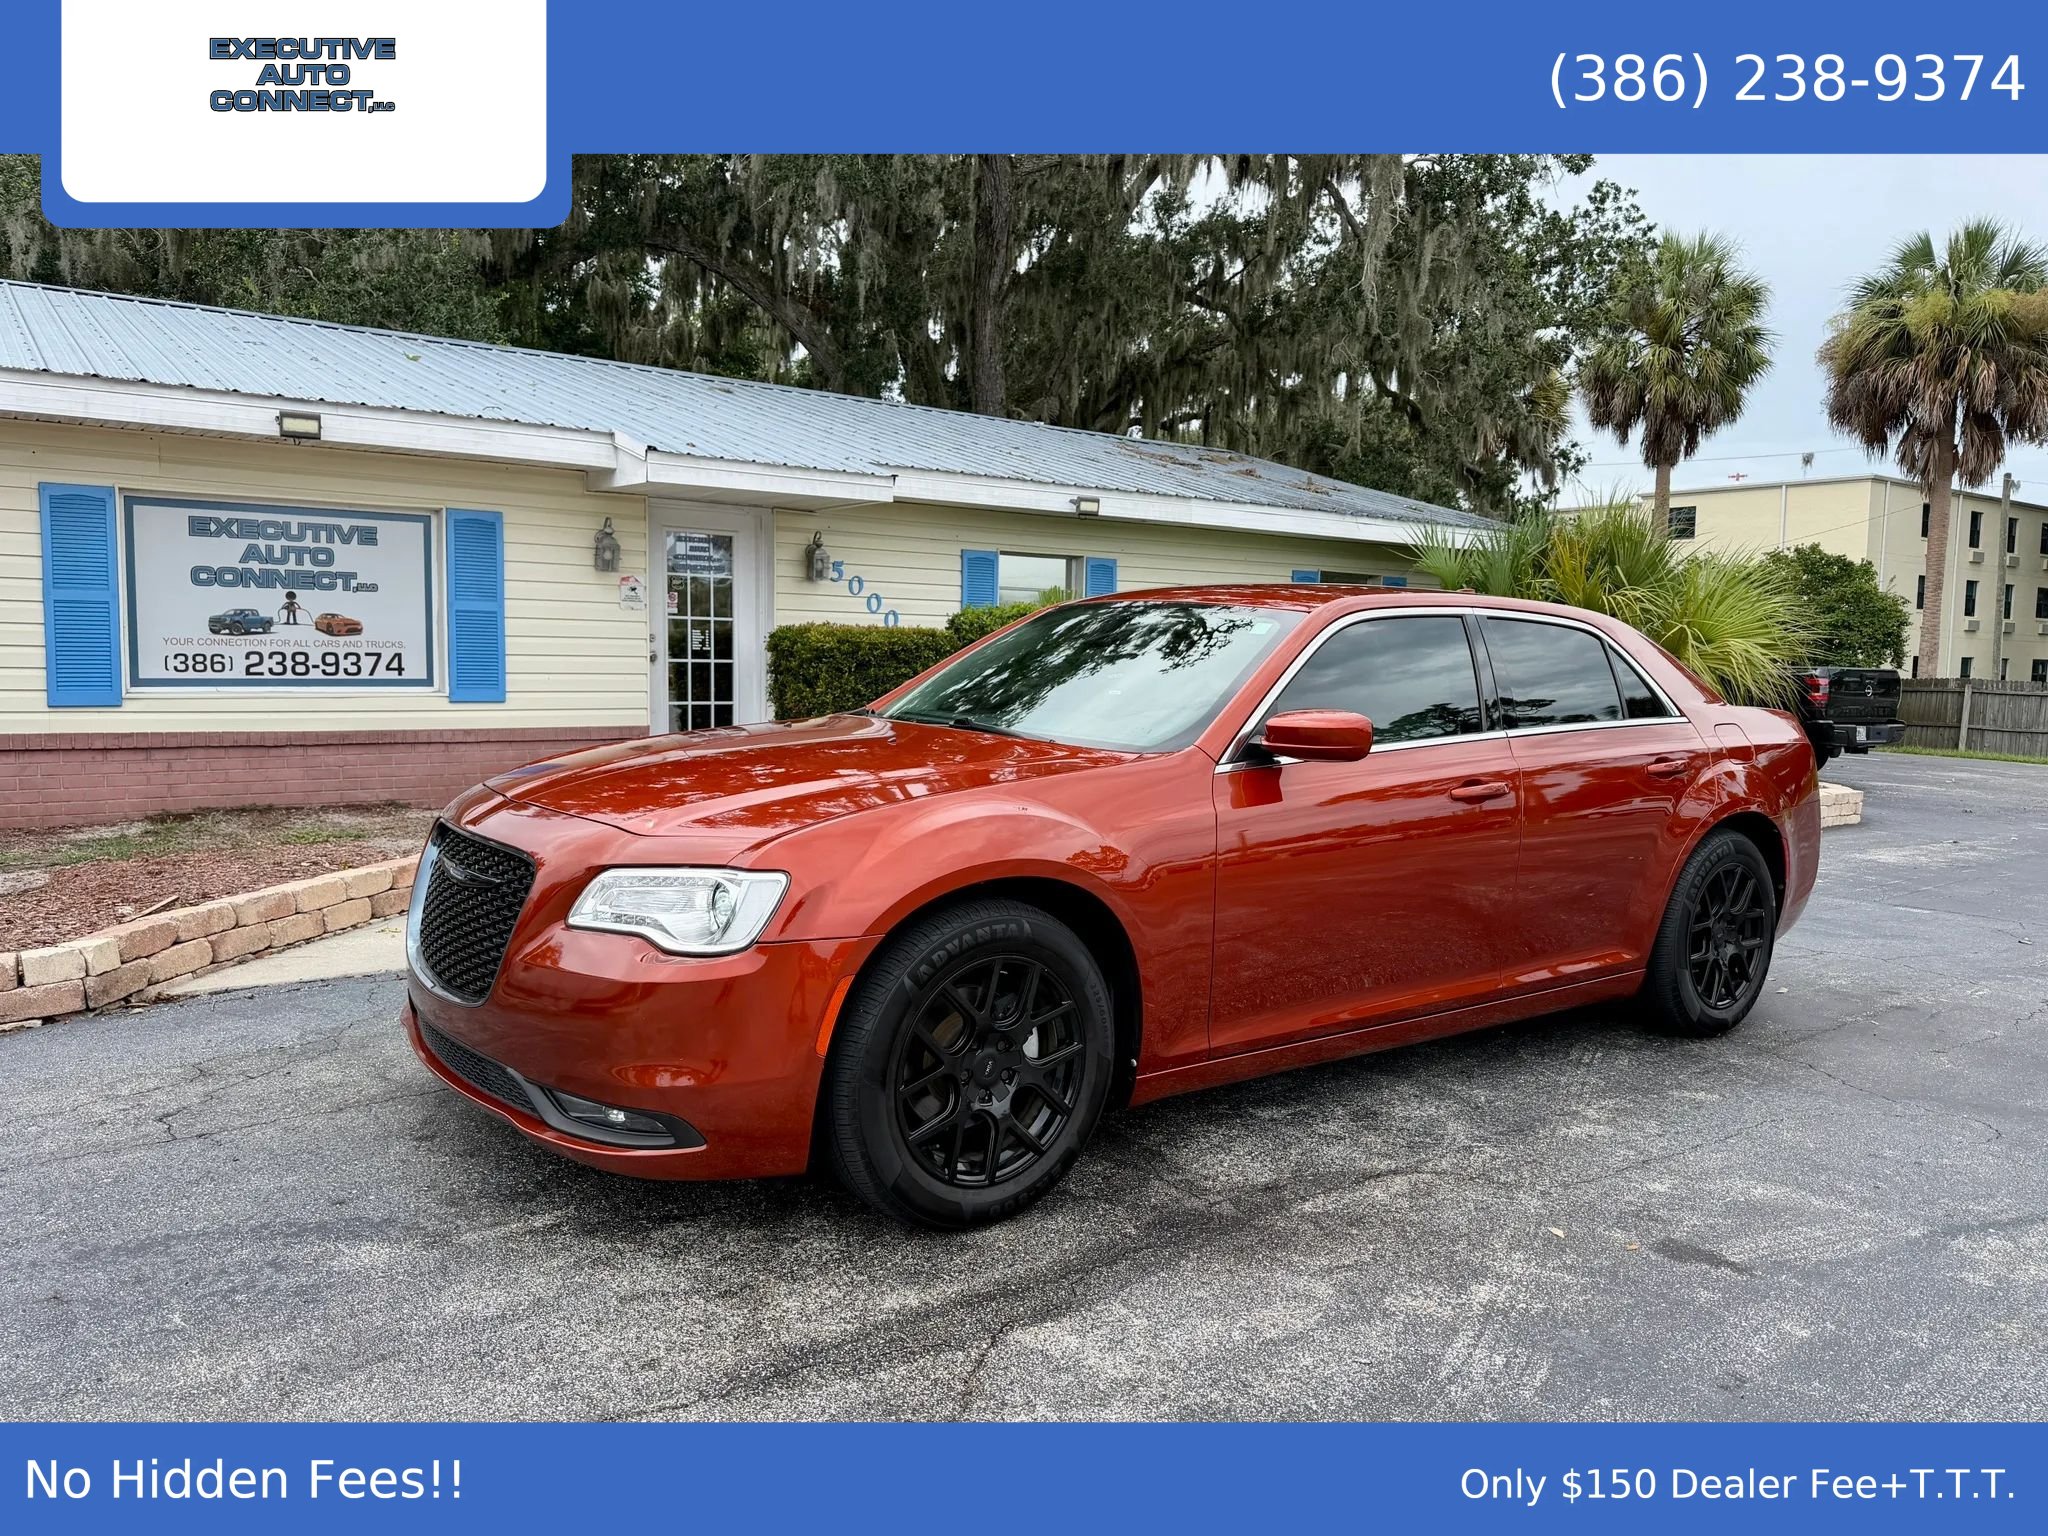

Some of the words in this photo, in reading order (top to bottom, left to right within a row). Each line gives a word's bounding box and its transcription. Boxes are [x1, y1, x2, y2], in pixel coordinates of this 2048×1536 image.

[188, 515, 378, 546] EXECUTIVE
[239, 543, 335, 567] AUTO
[163, 637, 194, 646] YOUR
[197, 637, 267, 647] CONNECTION
[269, 639, 291, 647] FOR
[293, 639, 311, 648] ALL
[313, 640, 341, 648] CARS
[342, 640, 363, 649] AND
[366, 640, 406, 649] TRUCKS.
[164, 653, 234, 673] (386)
[245, 650, 405, 677] 238-9374
[917, 923, 1019, 981] ADVANTA
